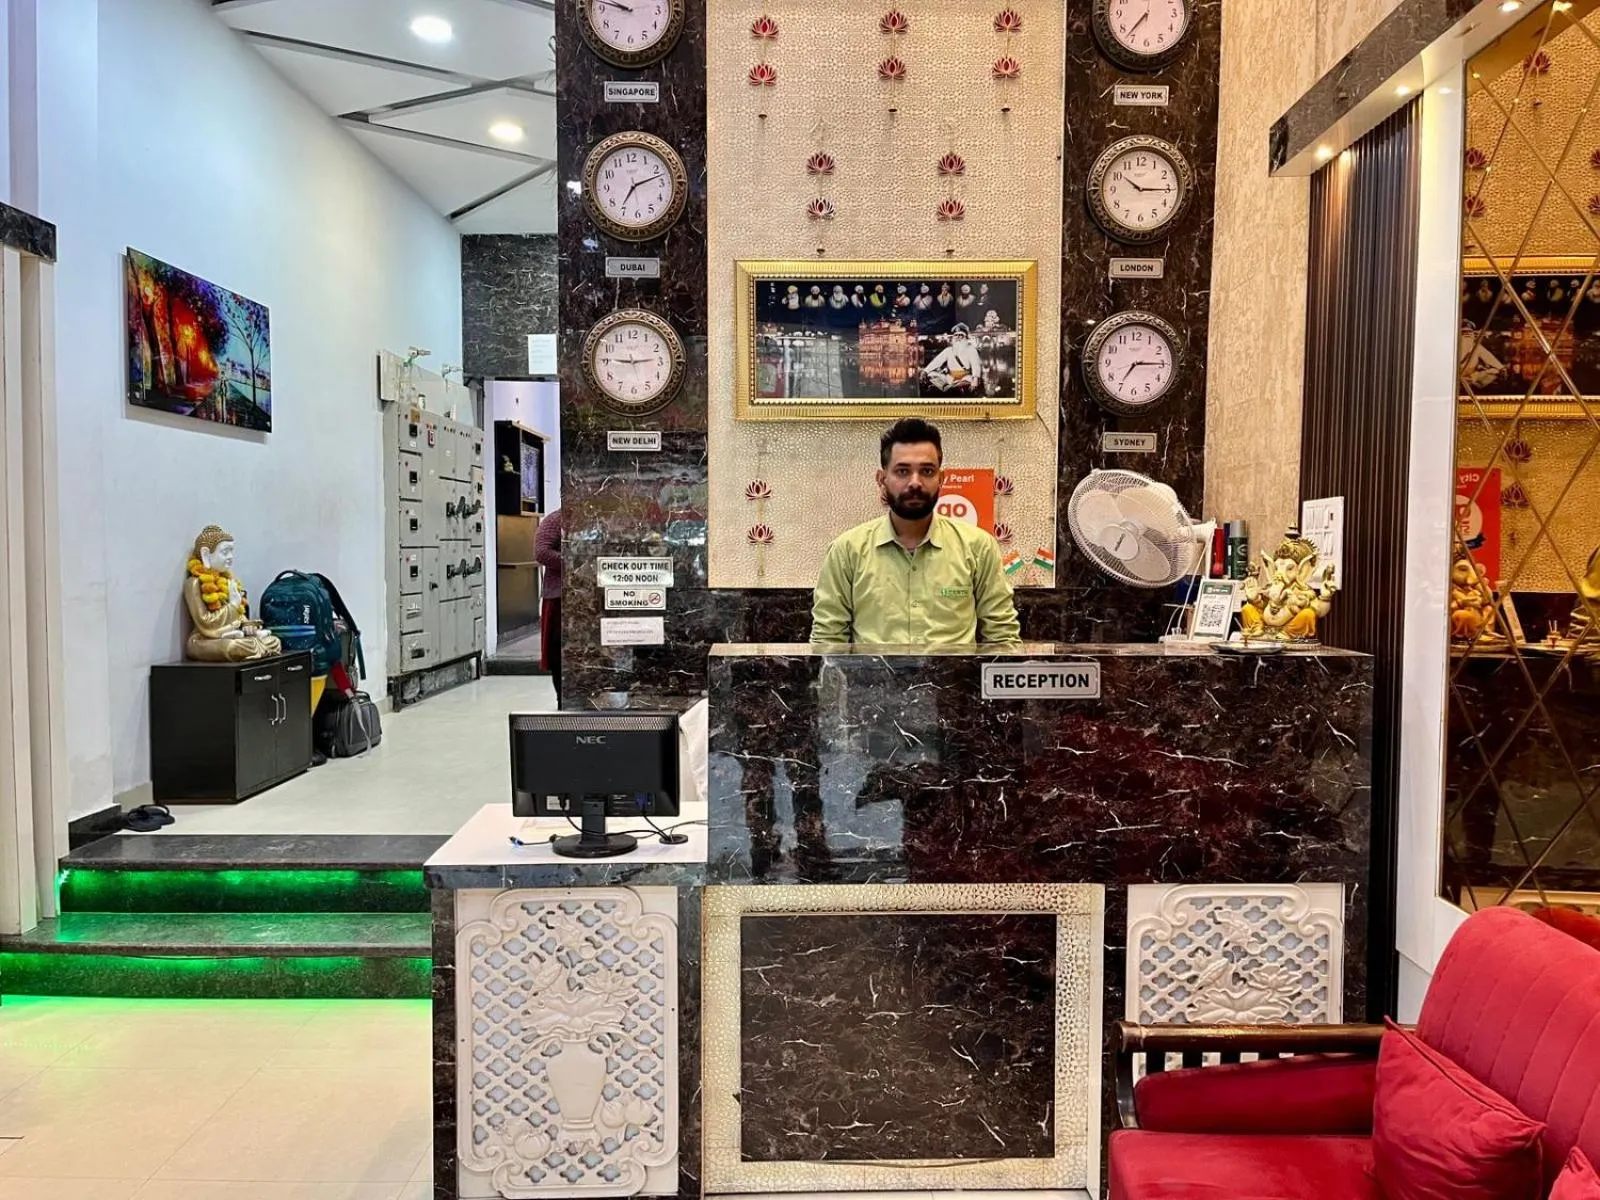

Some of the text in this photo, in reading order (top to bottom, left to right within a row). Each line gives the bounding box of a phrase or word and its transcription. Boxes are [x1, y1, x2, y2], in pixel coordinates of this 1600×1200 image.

[599, 4, 605, 13] 9
[655, 5, 661, 16] 3
[1116, 9, 1122, 18] 9
[1171, 9, 1178, 18] 3
[603, 20, 609, 29] 8
[652, 21, 657, 30] 4
[1120, 24, 1126, 33] 8
[1168, 23, 1173, 32] 4
[614, 30, 620, 40] 7
[627, 34, 634, 44] 6
[641, 30, 648, 40] 5
[1130, 34, 1136, 44] 7
[1157, 34, 1164, 43] 5
[1143, 38, 1150, 47] 6
[608, 88, 656, 96] SINGAPORE
[626, 153, 637, 163] 12
[643, 155, 648, 165] 1
[1136, 156, 1147, 167] 12
[613, 158, 622, 168] 11
[1123, 161, 1132, 170] 11
[1152, 160, 1156, 170] 1
[653, 164, 660, 174] 2
[605, 170, 614, 179] 10
[1113, 171, 1123, 181] 10
[1161, 170, 1168, 180] 2
[658, 178, 665, 188] 3
[603, 184, 610, 192] 9
[1110, 186, 1116, 195] 9
[657, 193, 663, 202] 4
[609, 198, 616, 207] 8
[1114, 200, 1120, 209] 8
[1161, 198, 1167, 207] 4
[621, 207, 627, 216] 7
[648, 204, 654, 214] 5
[1151, 209, 1158, 218] 5
[634, 209, 641, 219] 6
[1124, 209, 1130, 219] 7
[1137, 213, 1144, 223] 6
[620, 263, 646, 271] DUBAI
[615, 334, 623, 343] 11
[628, 330, 638, 339] 12
[643, 333, 648, 342] 1
[1132, 332, 1142, 341] 12
[1119, 335, 1127, 344] 11
[1147, 336, 1152, 345] 1
[605, 344, 614, 353] 10
[653, 343, 659, 353] 2
[1108, 345, 1118, 354] 10
[1156, 346, 1162, 355] 2
[657, 356, 664, 367] 3
[1105, 358, 1111, 367] 9
[606, 372, 614, 381] 8
[656, 371, 660, 380] 4
[1108, 372, 1114, 382] 8
[1156, 374, 1161, 382] 4
[618, 381, 624, 391] 7
[631, 386, 638, 395] 6
[644, 381, 651, 391] 5
[1118, 382, 1124, 392] 7
[1144, 383, 1151, 392] 5
[1130, 387, 1137, 396] 6
[612, 435, 656, 444] NEW DELHI
[1114, 438, 1146, 446] SYDNEY
[950, 474, 974, 482] Pearl
[601, 562, 629, 570] CHECK
[992, 674, 1089, 688] RECEPTION
[576, 736, 606, 744] NEC
